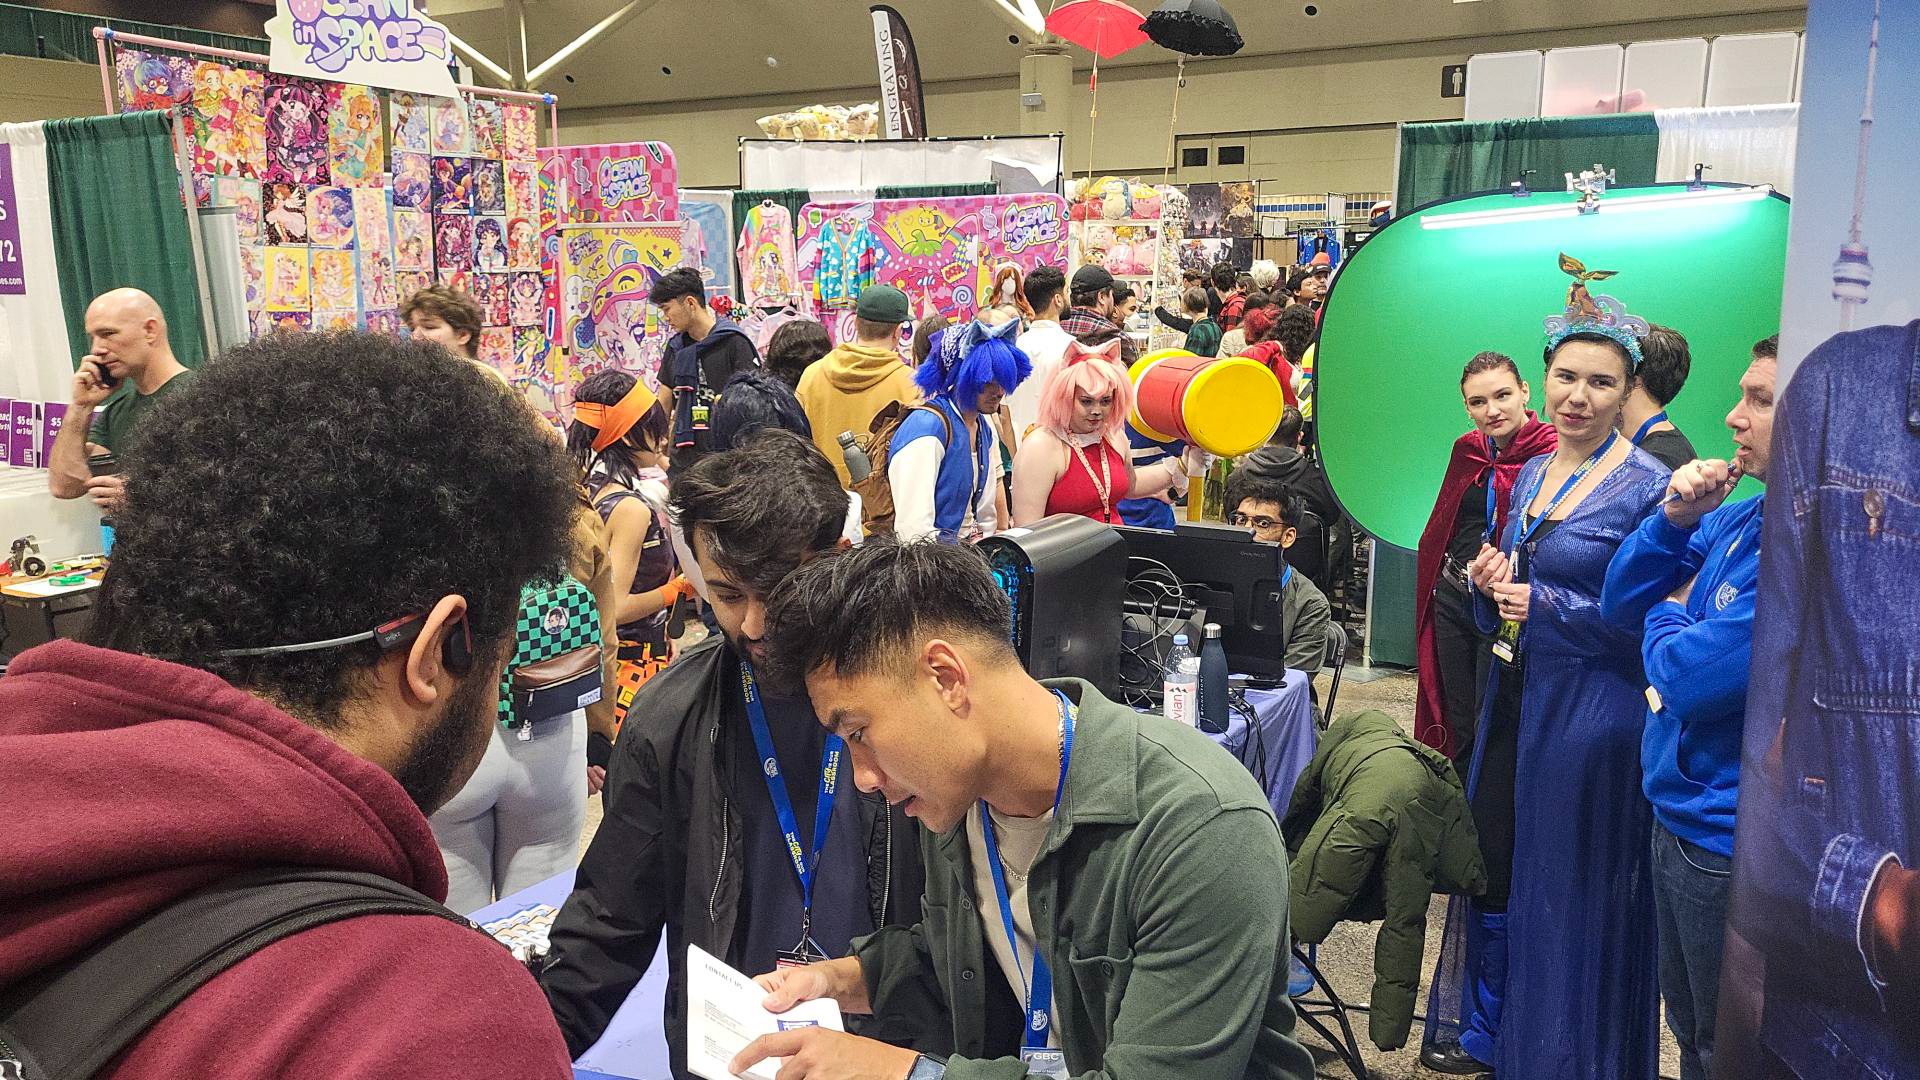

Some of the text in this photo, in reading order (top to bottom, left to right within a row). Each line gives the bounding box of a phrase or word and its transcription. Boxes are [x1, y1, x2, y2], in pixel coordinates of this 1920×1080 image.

[293, 16, 425, 73] in SPACE
[879, 29, 900, 132] ENGRAVING
[600, 157, 645, 187] OCEAN
[605, 174, 650, 206] SPACE
[1004, 204, 1055, 233] OCEAN
[1009, 220, 1059, 251] SPACE
[50, 417, 62, 427] $5
[828, 751, 840, 795] CLASSROOM
[785, 833, 803, 875] CLASSROOM
[1033, 1052, 1060, 1061] GBC
